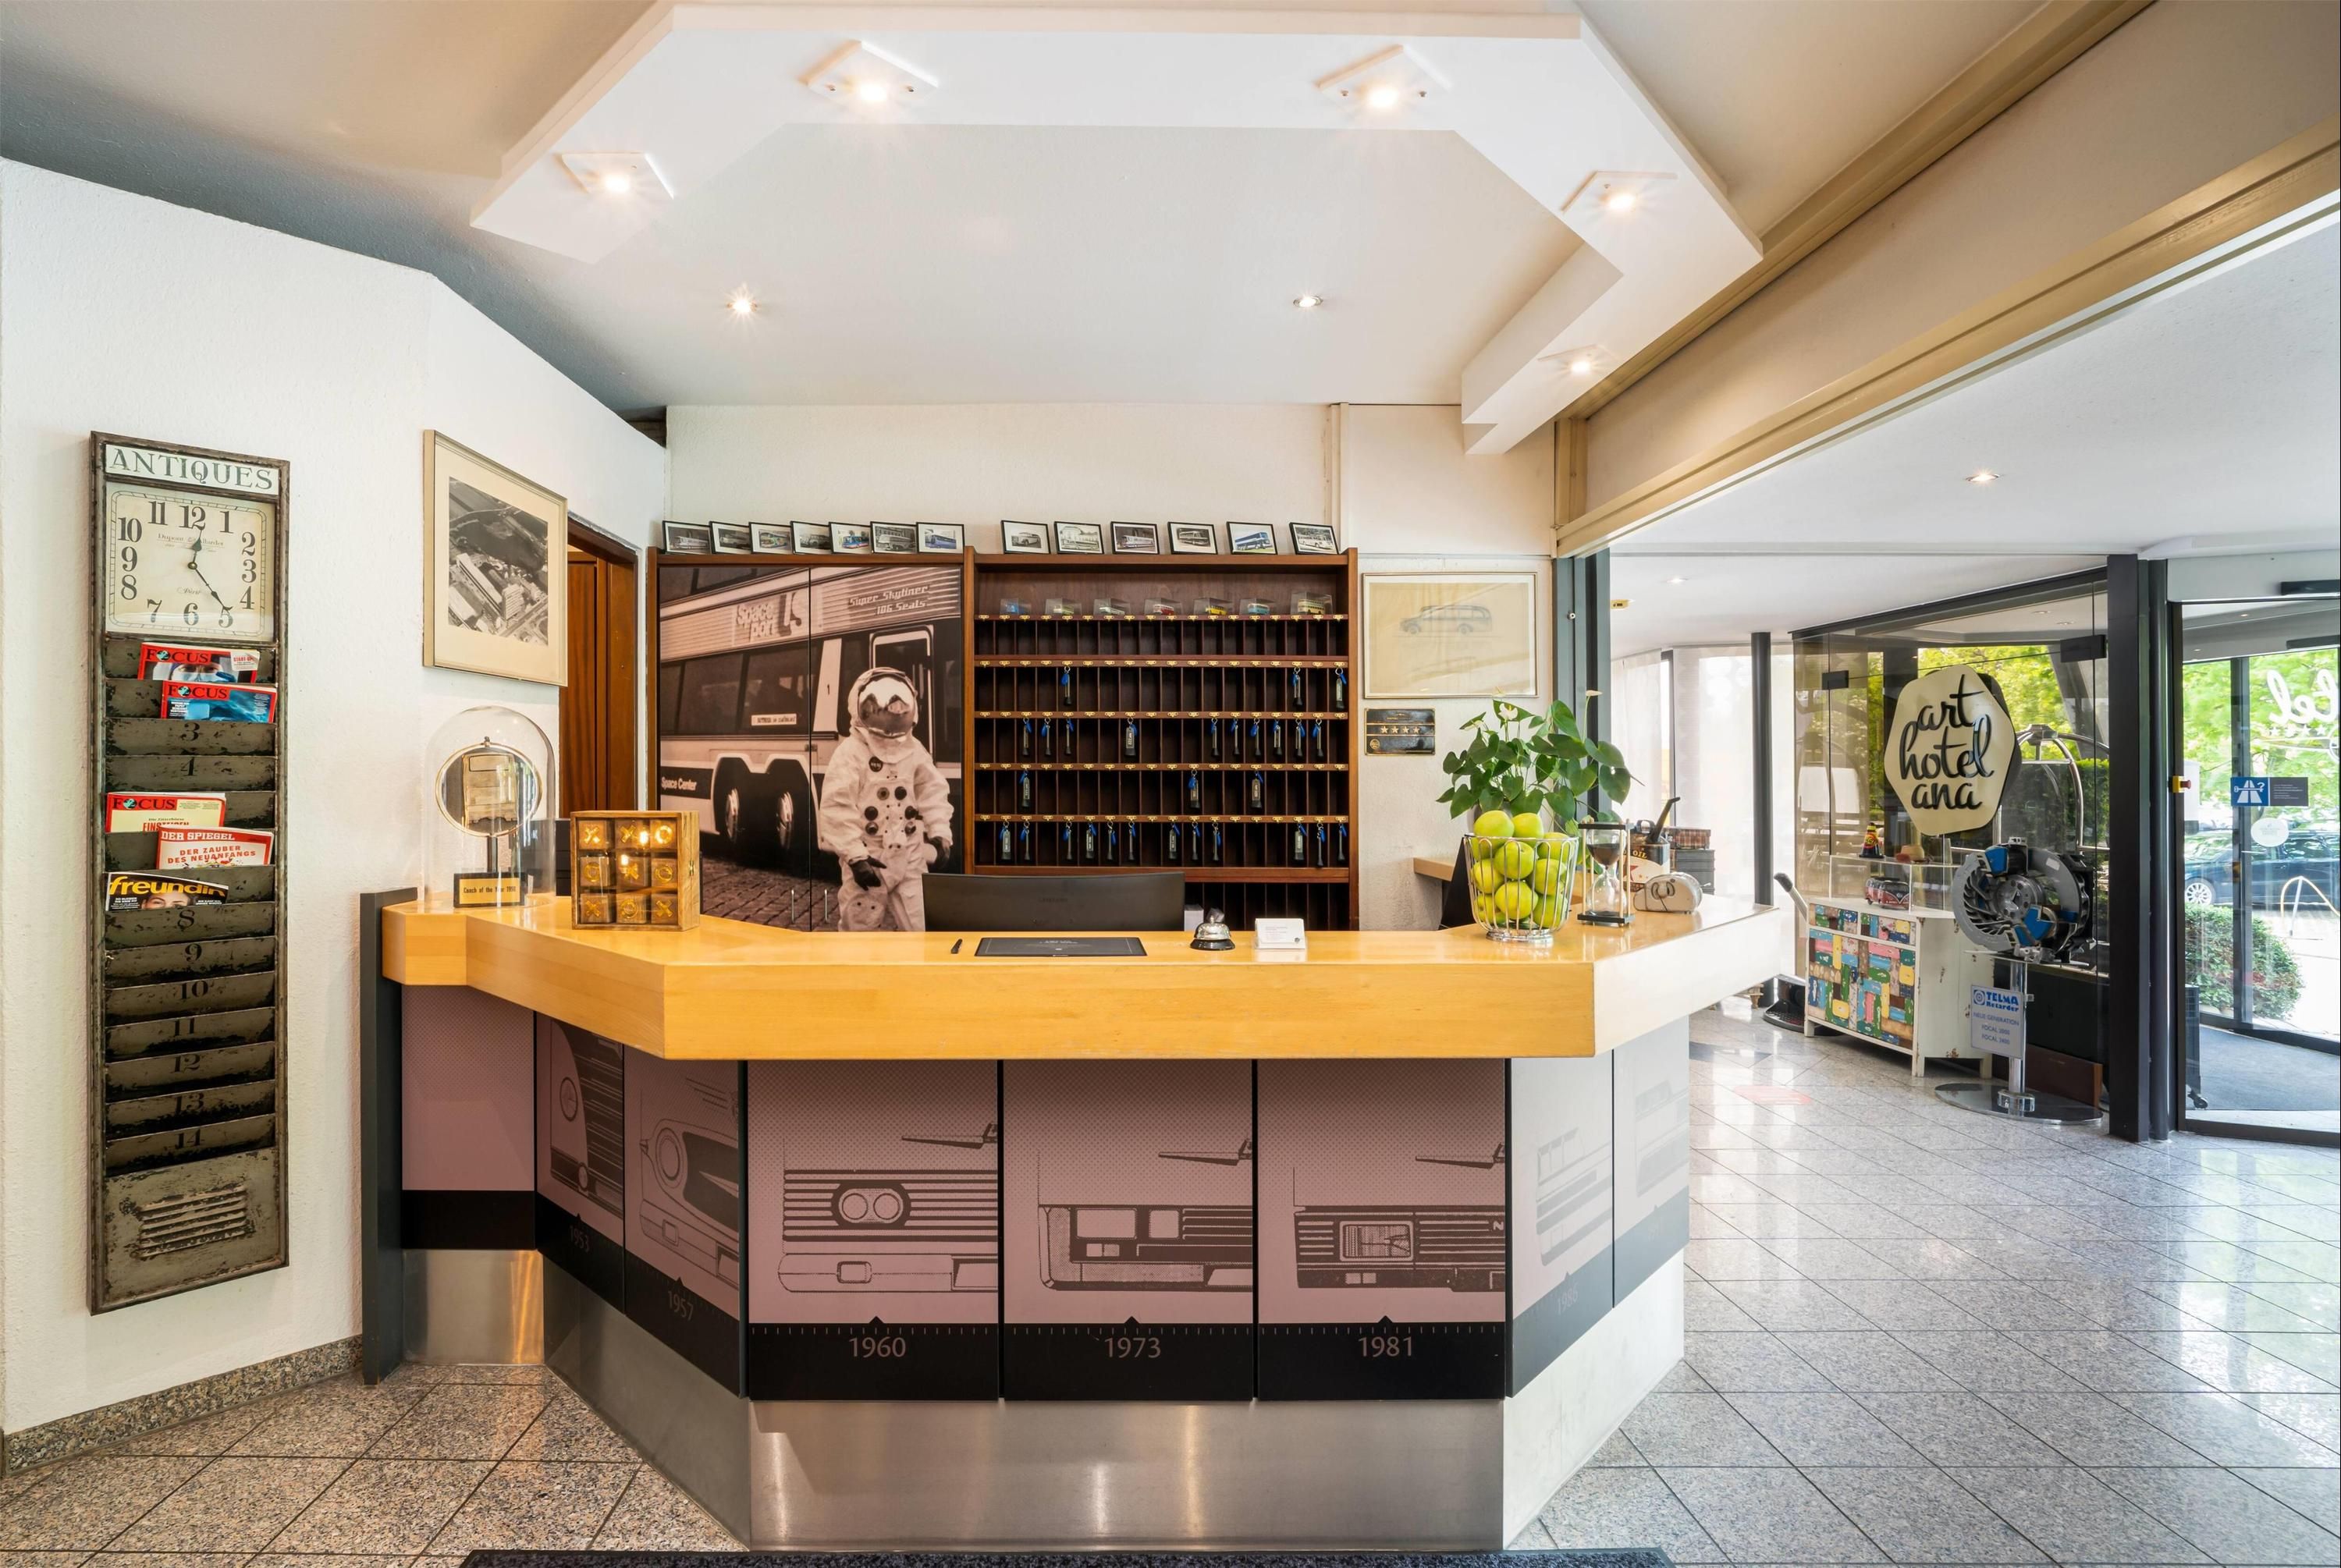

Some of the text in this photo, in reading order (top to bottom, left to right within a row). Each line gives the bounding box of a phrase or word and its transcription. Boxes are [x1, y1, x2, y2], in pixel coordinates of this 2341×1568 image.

[109, 449, 272, 490] ANTIQUES
[148, 501, 168, 525] 11
[179, 506, 206, 530] 12
[219, 511, 234, 534] 1
[118, 517, 142, 542] 10
[242, 531, 256, 556] 2
[122, 547, 138, 572] 9
[242, 559, 257, 583] 3
[121, 575, 137, 600] 8
[240, 586, 255, 609] 4
[883, 586, 929, 600] Skyliner
[147, 599, 162, 623] 7
[183, 602, 199, 626] 6
[218, 606, 233, 628] 5
[146, 649, 210, 663] FOCUS
[168, 684, 227, 698] FOCUS
[1916, 674, 1985, 731] art
[181, 722, 199, 741] 3
[1899, 714, 1995, 780] hotel
[180, 757, 197, 776] 4
[661, 777, 697, 791] Space Center
[112, 797, 175, 810] FOCUS
[1911, 782, 1983, 811] ana
[162, 831, 235, 840] DER SPIEGEL
[190, 850, 256, 862] NEUANFANGS
[1632, 850, 1647, 859] OIL
[109, 876, 225, 896] freundin
[185, 943, 202, 962] 9
[179, 980, 208, 999] 10
[1986, 992, 2019, 1005] TELMA
[1986, 1002, 2019, 1012] Retarder
[172, 1017, 195, 1036] 11
[172, 1054, 201, 1073] 12
[569, 1224, 591, 1253] 1953
[667, 1290, 694, 1321] 1957
[849, 1336, 906, 1358] 1960
[1105, 1337, 1161, 1358] 1973
[1359, 1336, 1412, 1357] 1981
